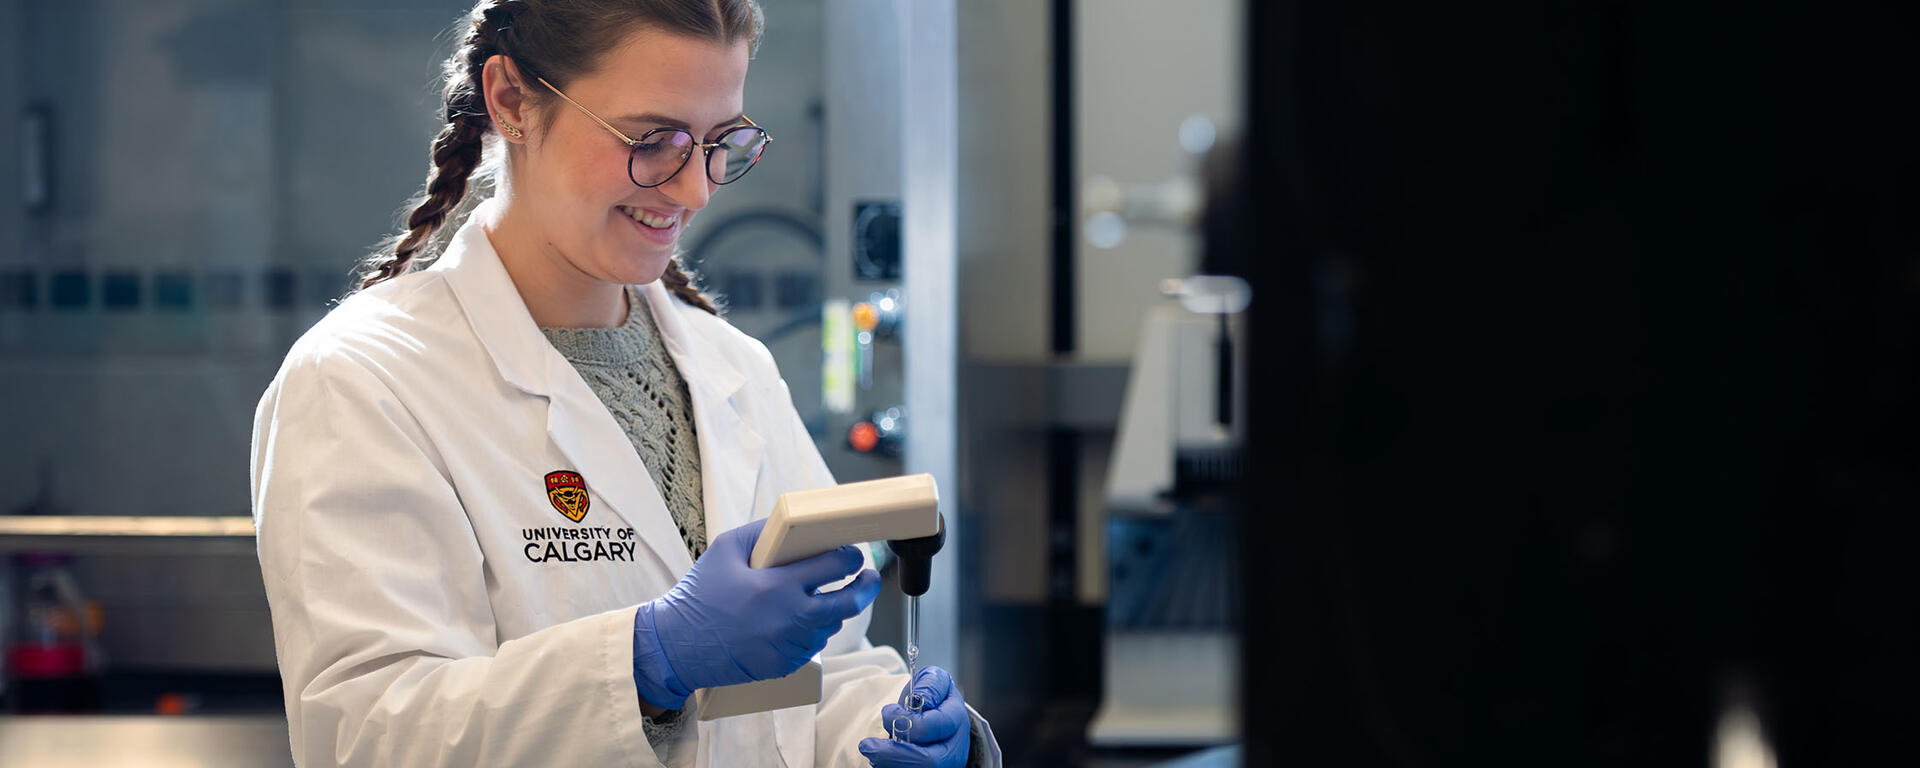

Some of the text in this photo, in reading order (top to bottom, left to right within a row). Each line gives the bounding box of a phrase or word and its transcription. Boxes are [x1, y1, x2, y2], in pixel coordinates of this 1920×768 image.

[522, 527, 635, 541] UNIVERSITY OF
[523, 540, 636, 563] CALGARY
